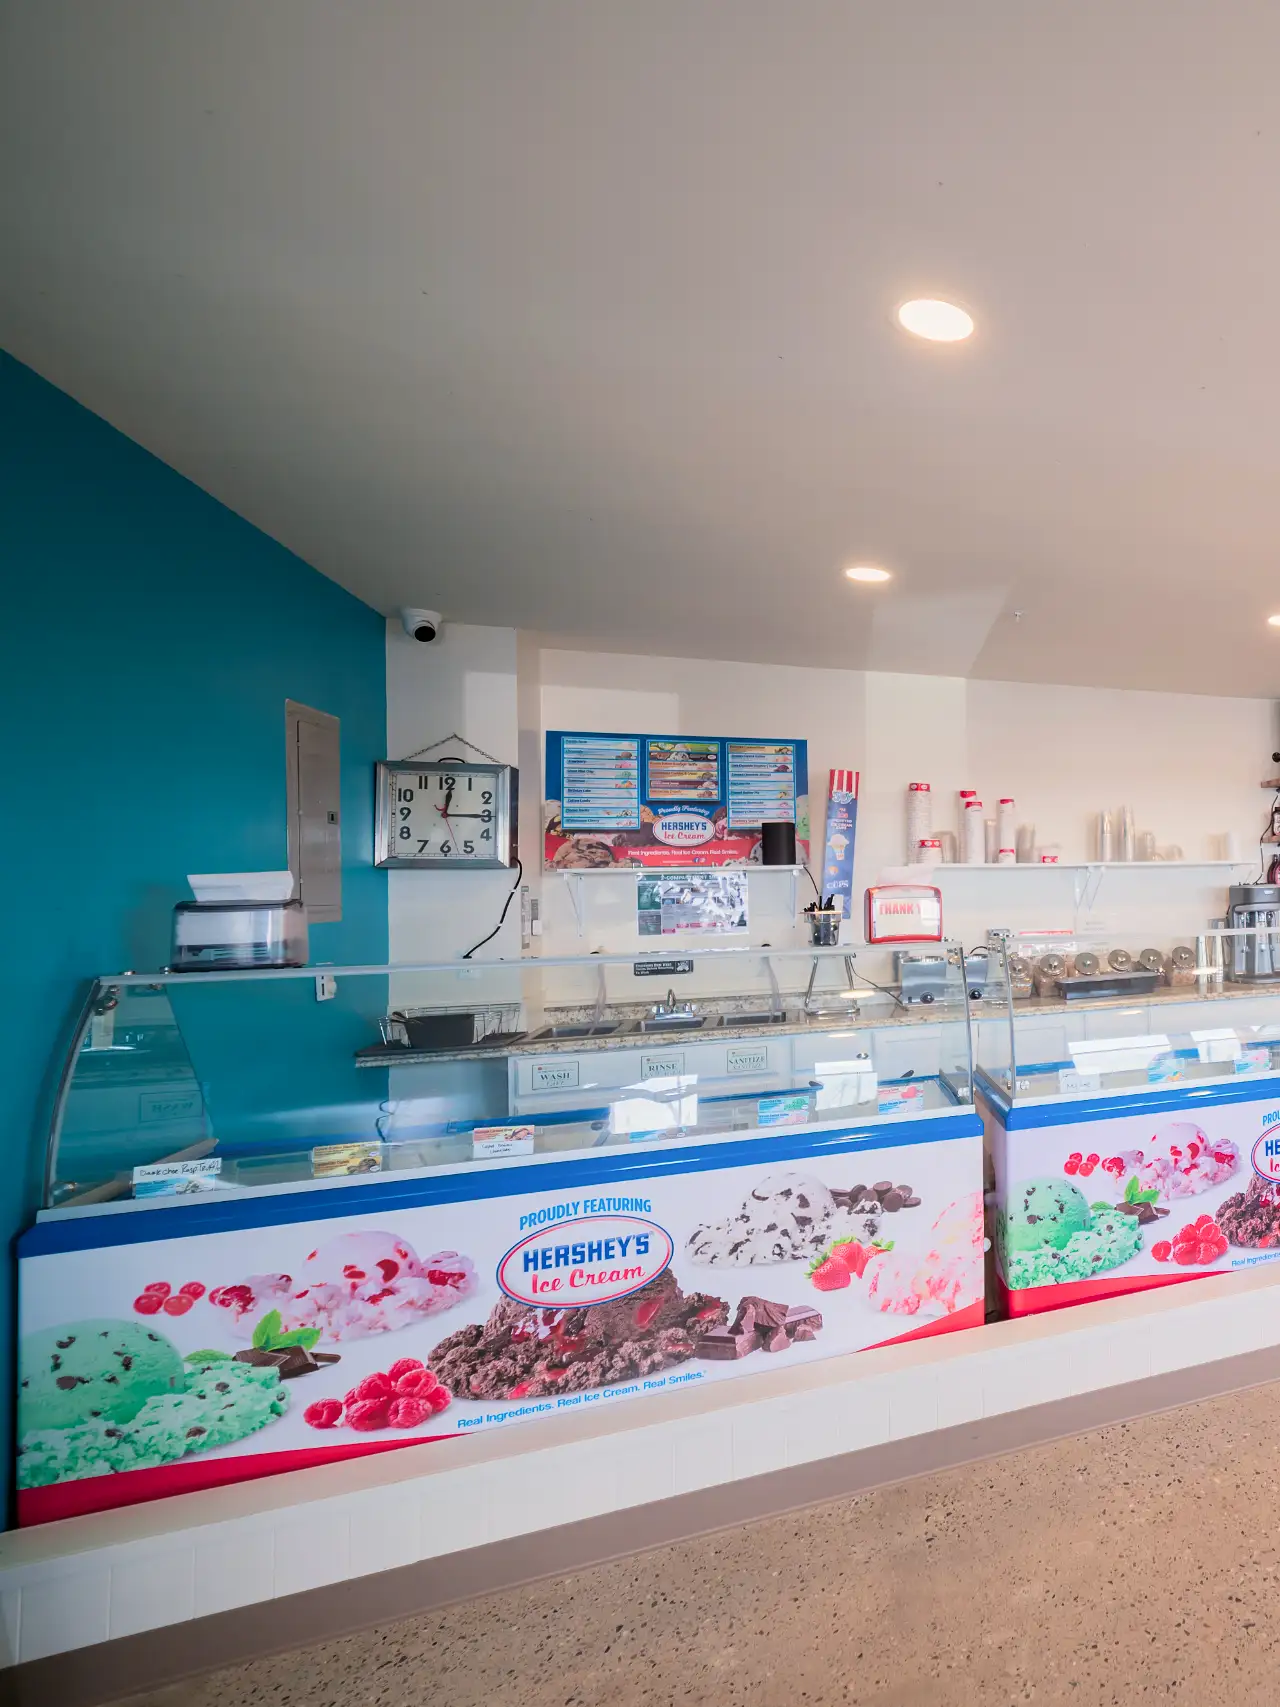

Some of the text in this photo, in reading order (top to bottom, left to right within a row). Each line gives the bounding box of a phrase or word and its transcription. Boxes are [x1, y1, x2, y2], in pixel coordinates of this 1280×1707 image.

[439, 776, 456, 791] 12
[468, 777, 473, 791] 1
[397, 788, 414, 802] 10
[480, 790, 493, 805] 2
[399, 806, 412, 821] 9
[480, 809, 492, 823] 3
[399, 825, 412, 840] 8
[661, 821, 707, 831] HERSHEY'S
[479, 828, 492, 841] 4
[664, 831, 705, 839] Ice Cream
[416, 839, 429, 853] 7
[439, 839, 452, 854] 6
[463, 840, 475, 854] 5
[879, 902, 913, 915] THANK
[648, 1063, 678, 1072] RINSE
[540, 1072, 570, 1081] WASH
[519, 1197, 652, 1231] PROUDLY FEATURING
[523, 1232, 649, 1273] HERSHEY'S
[532, 1265, 646, 1294] Ice Cream
[457, 1370, 705, 1429] Real Ingredients. Real Ice Cream. Real Smiles.
